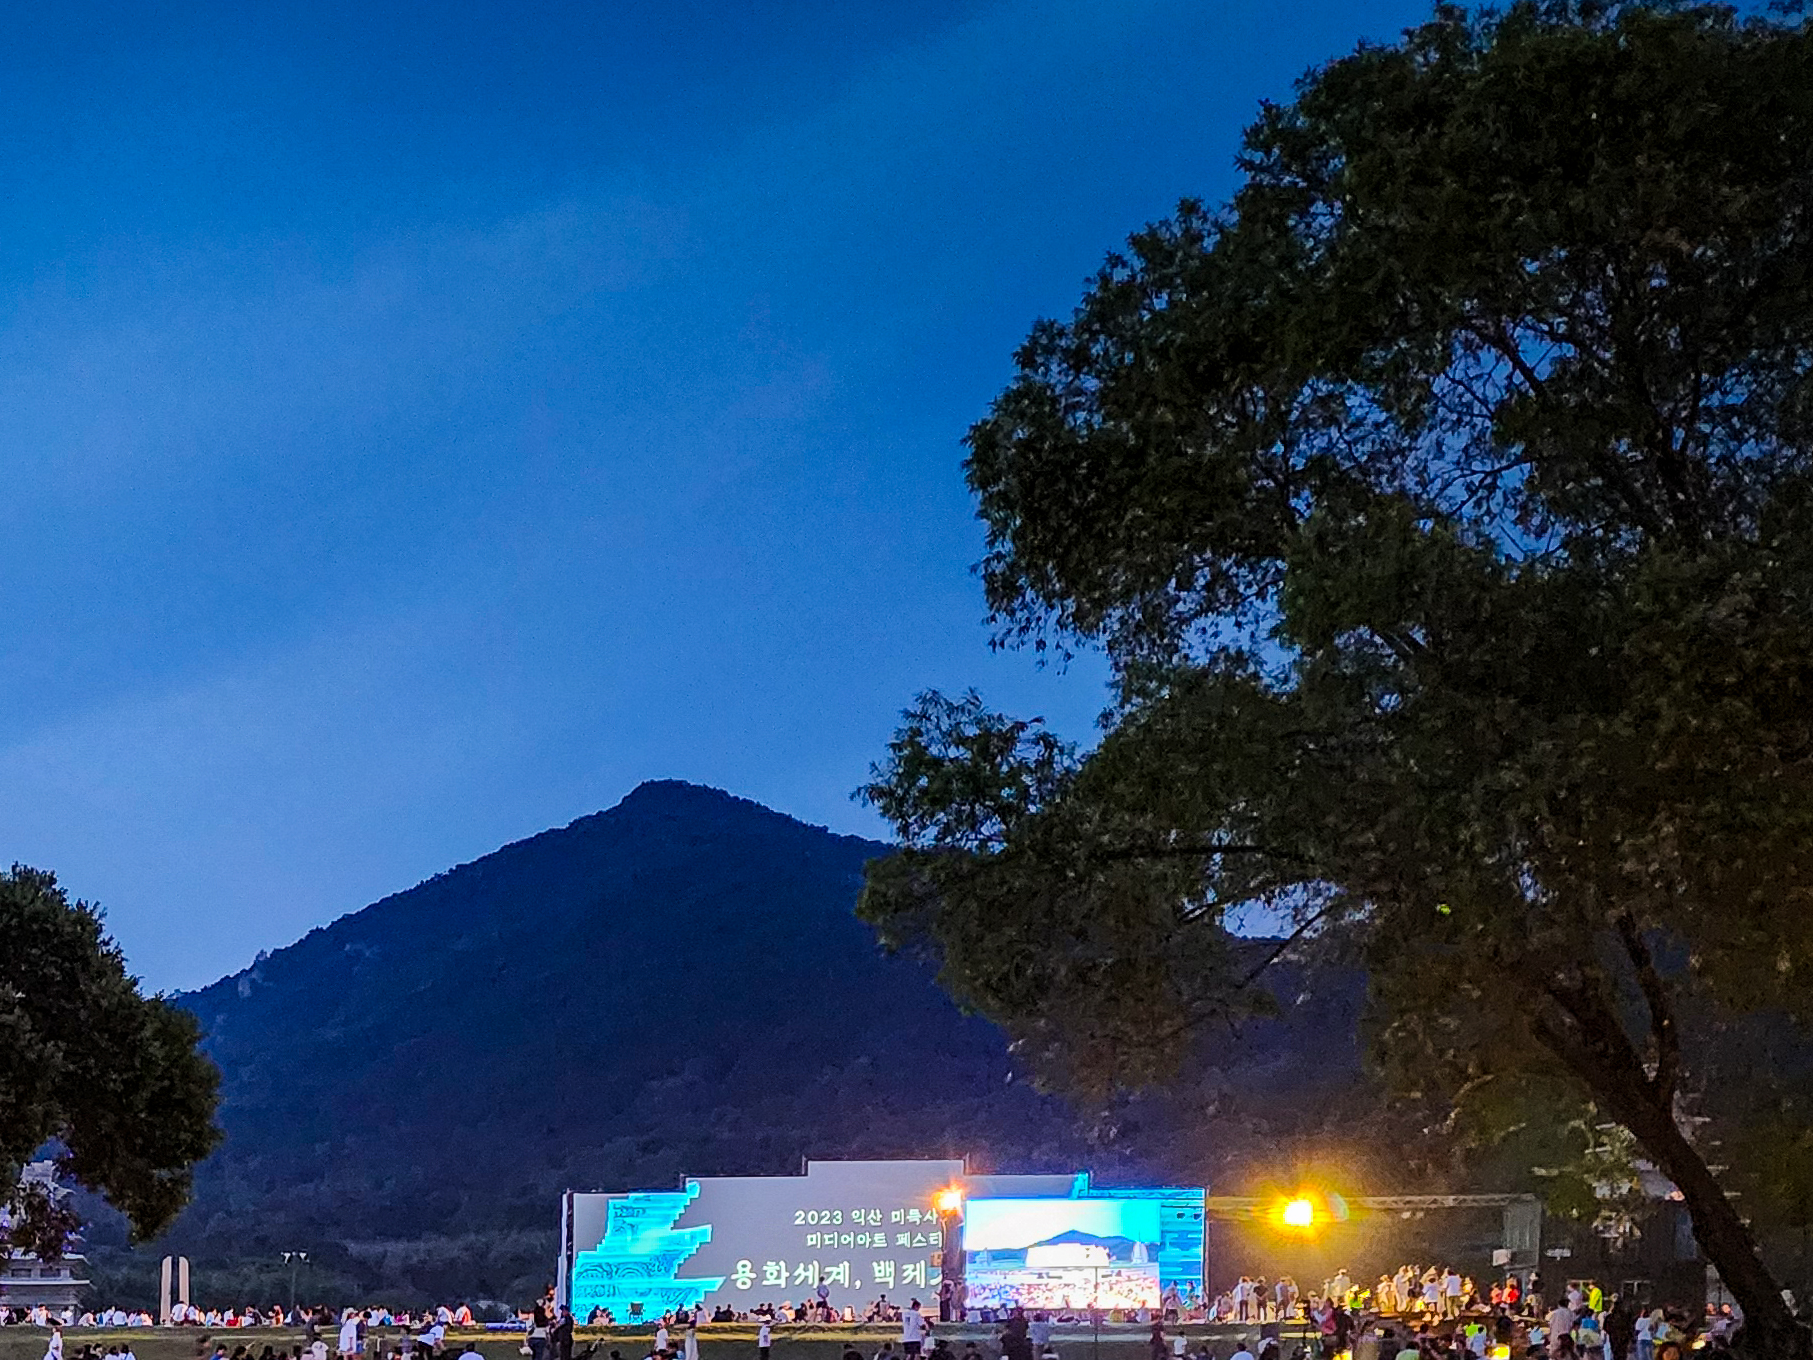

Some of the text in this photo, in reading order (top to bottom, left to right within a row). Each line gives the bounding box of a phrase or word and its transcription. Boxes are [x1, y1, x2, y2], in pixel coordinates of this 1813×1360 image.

[794, 1210, 843, 1226] 2023
[851, 1208, 883, 1226] 익산
[806, 1231, 888, 1249] 미디어아트
[730, 1259, 862, 1290] 용화세계,
